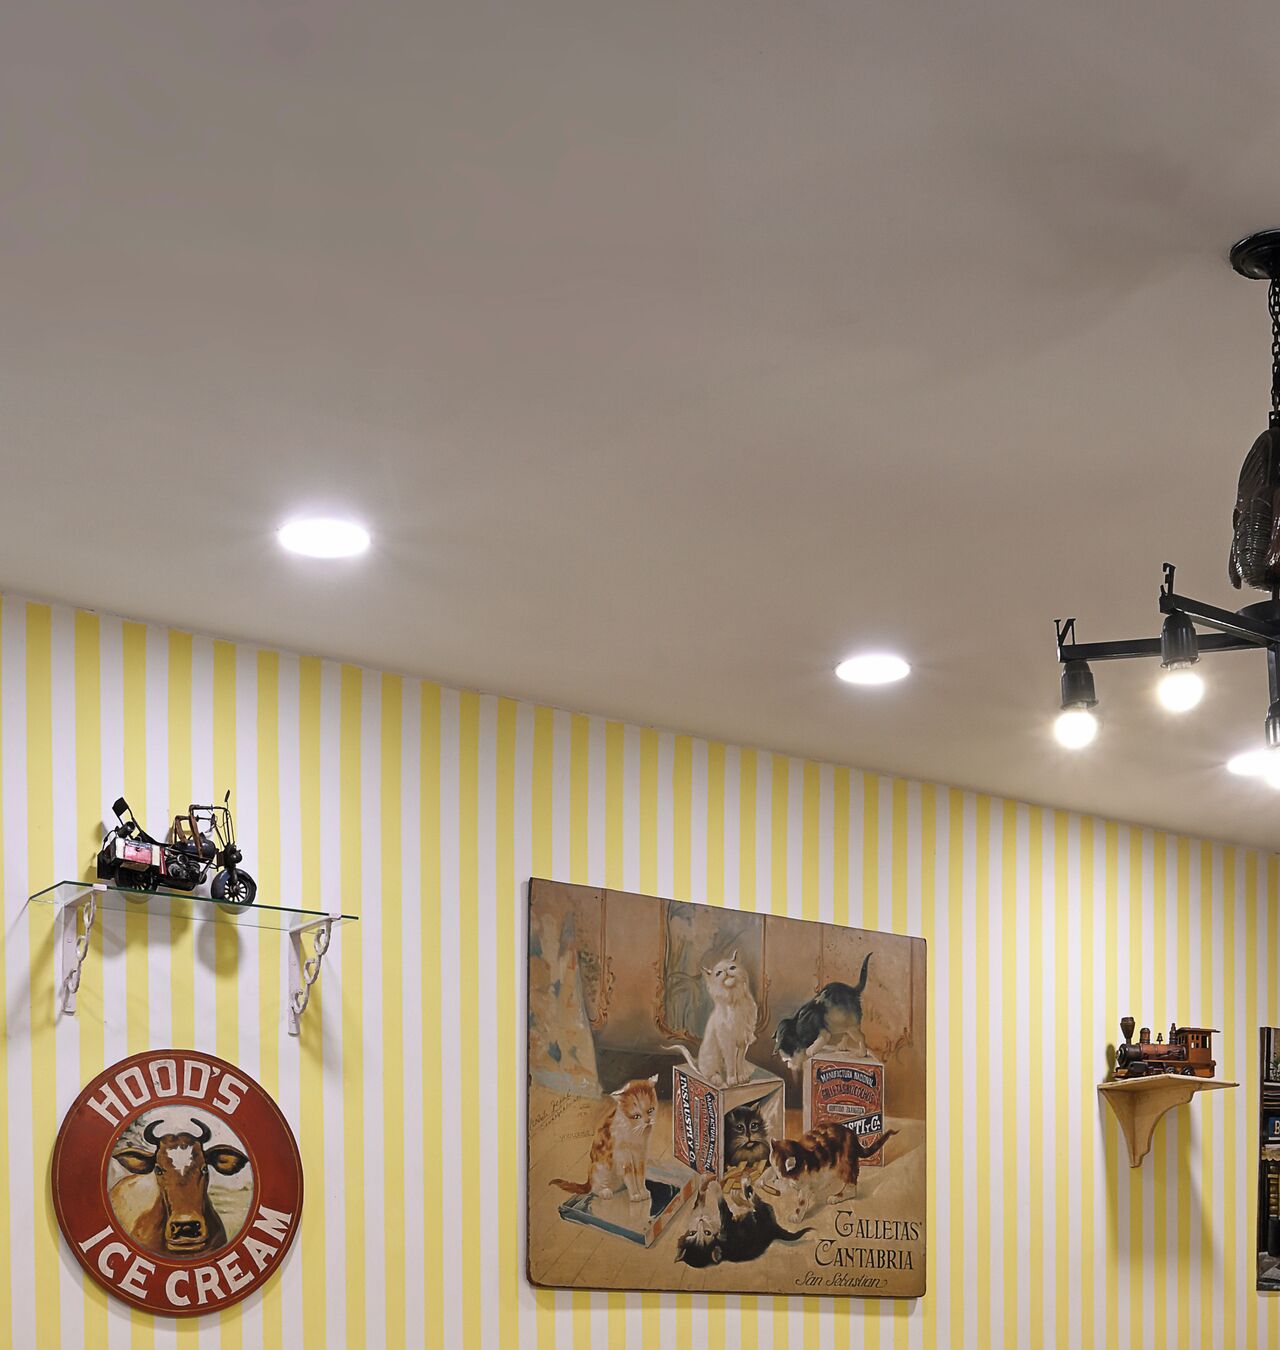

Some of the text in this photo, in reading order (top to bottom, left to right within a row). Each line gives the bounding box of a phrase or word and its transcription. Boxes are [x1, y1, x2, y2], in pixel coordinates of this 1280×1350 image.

[86, 1059, 250, 1127] HOOD'S
[78, 1204, 293, 1307] ICE CREAM
[814, 1238, 914, 1270] CANTABRIA
[795, 1271, 888, 1289] San Sebastian
